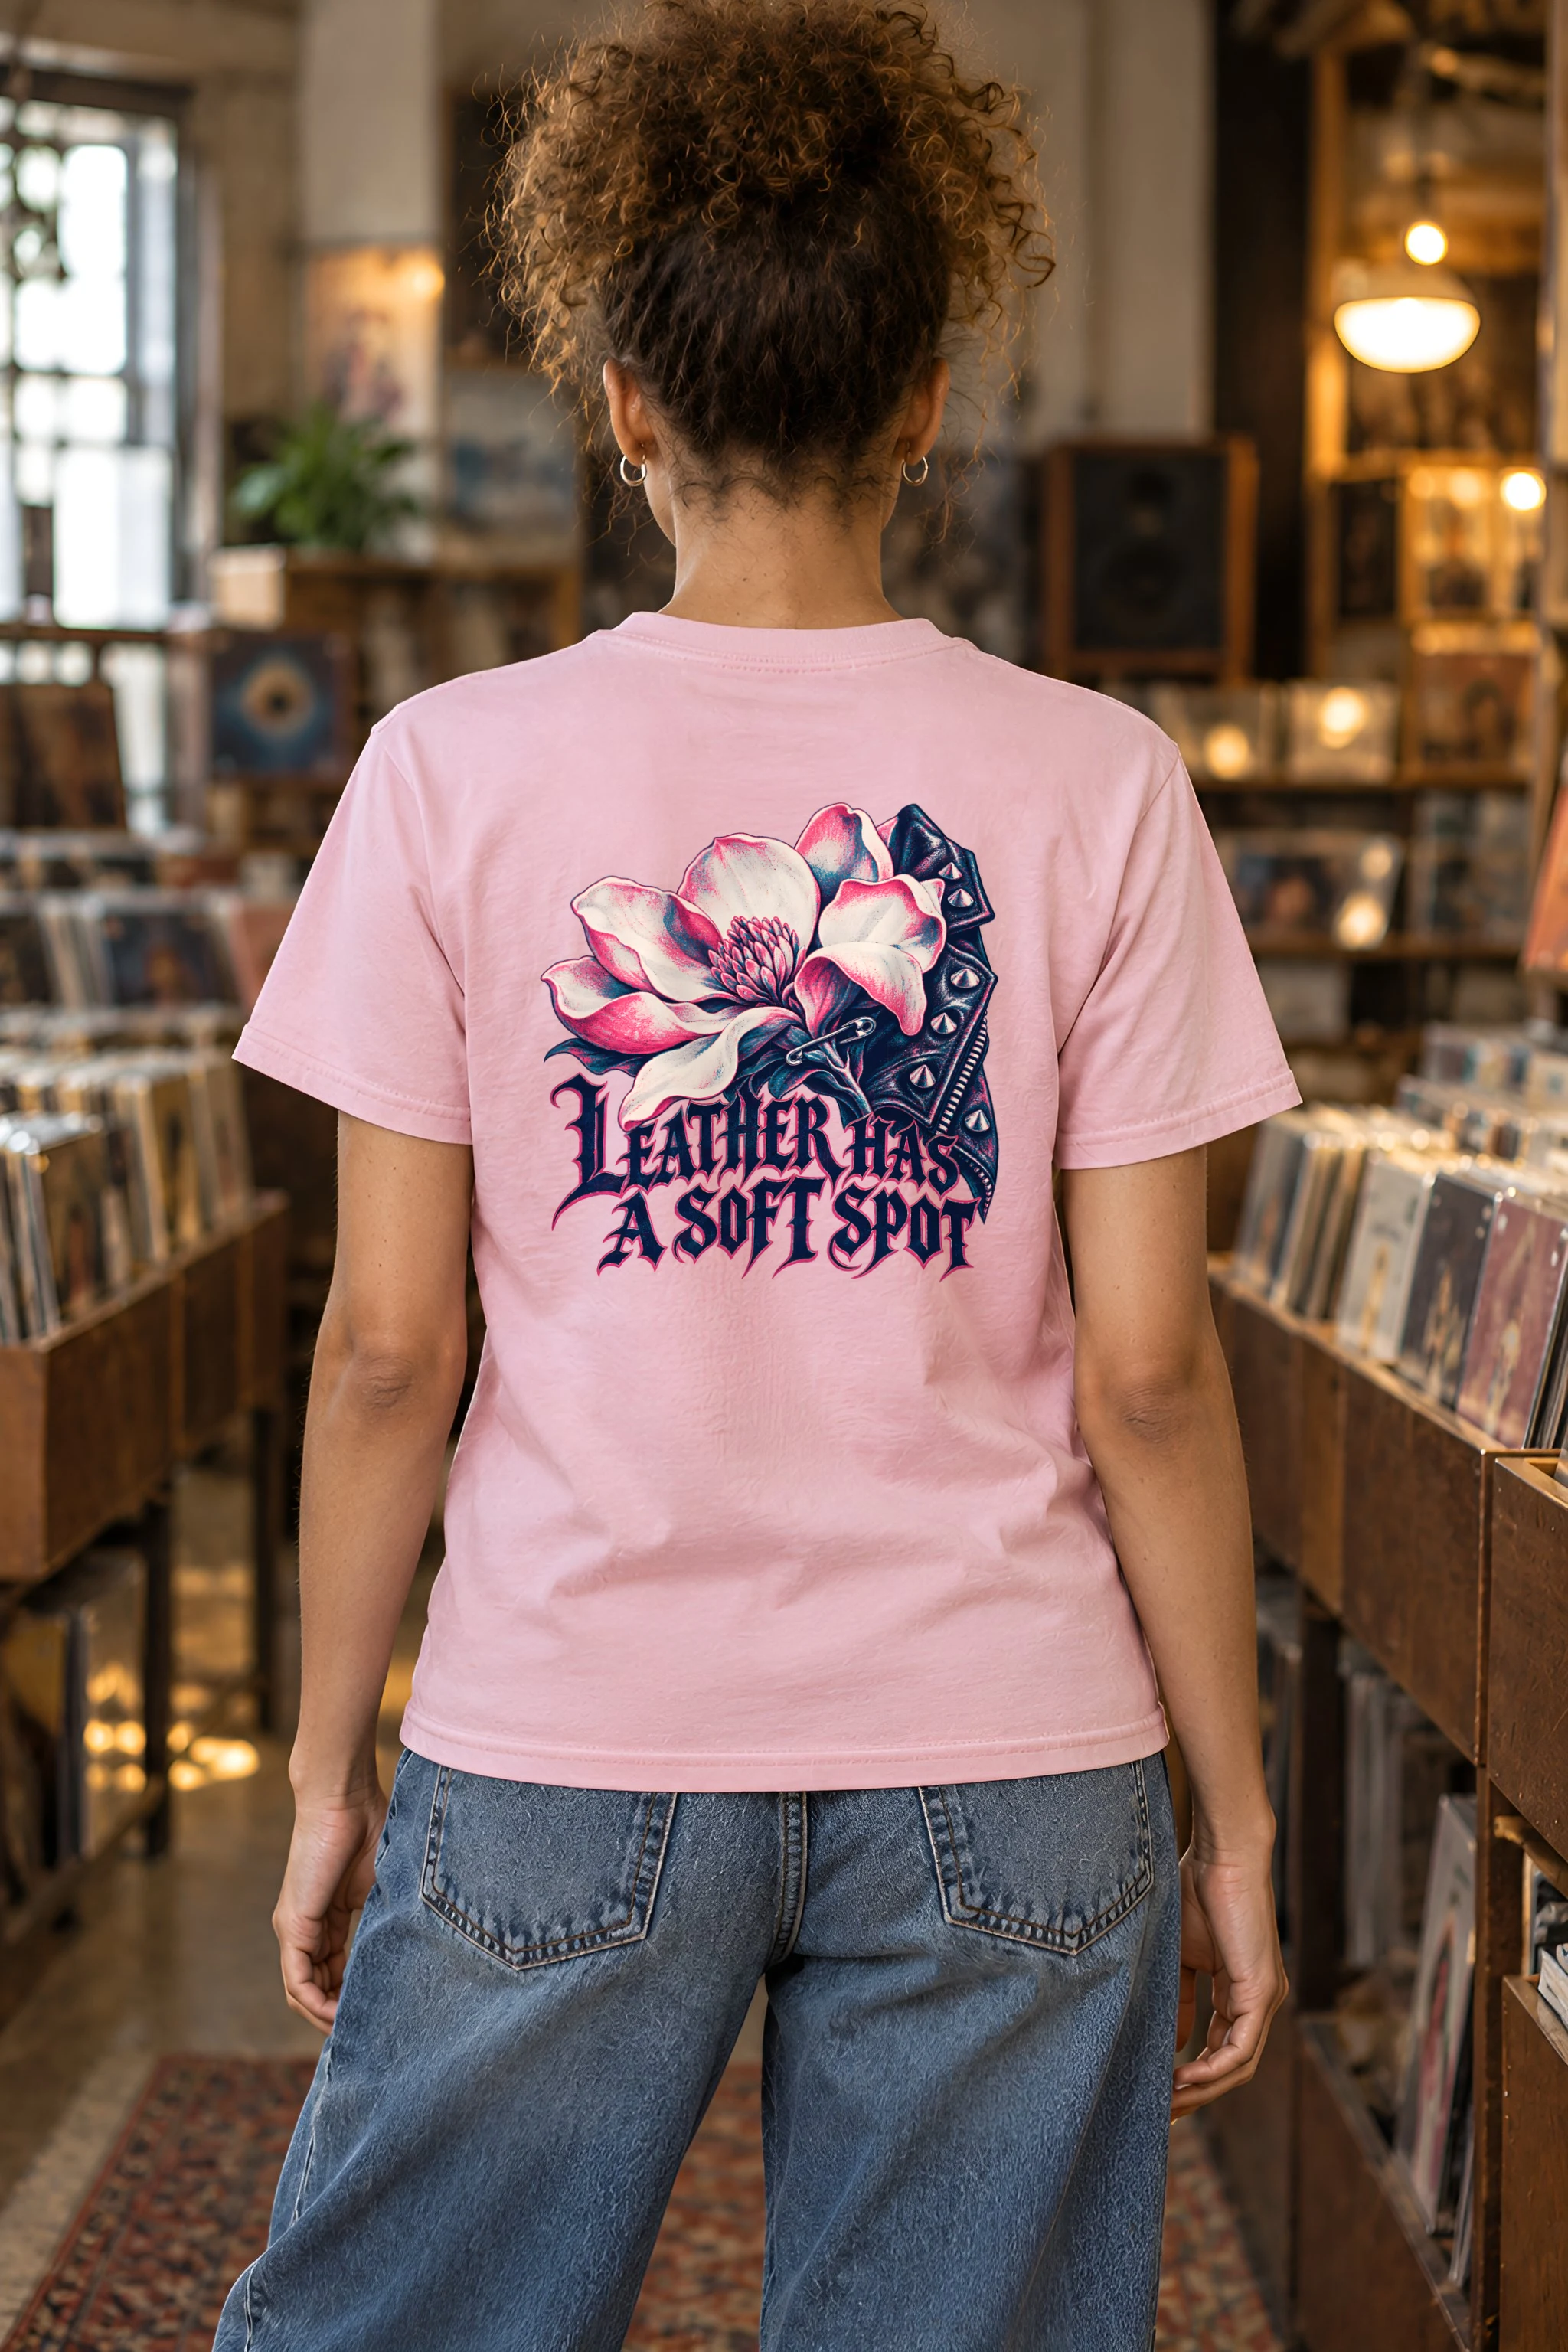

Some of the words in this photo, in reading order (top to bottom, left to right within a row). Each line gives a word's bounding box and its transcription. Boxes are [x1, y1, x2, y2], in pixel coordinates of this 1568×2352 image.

[550, 1073, 843, 1230] LEATHER
[842, 1115, 961, 1197] HAS
[597, 1189, 666, 1276] A
[672, 1176, 829, 1279] SOFT
[828, 1186, 980, 1282] SPOT
